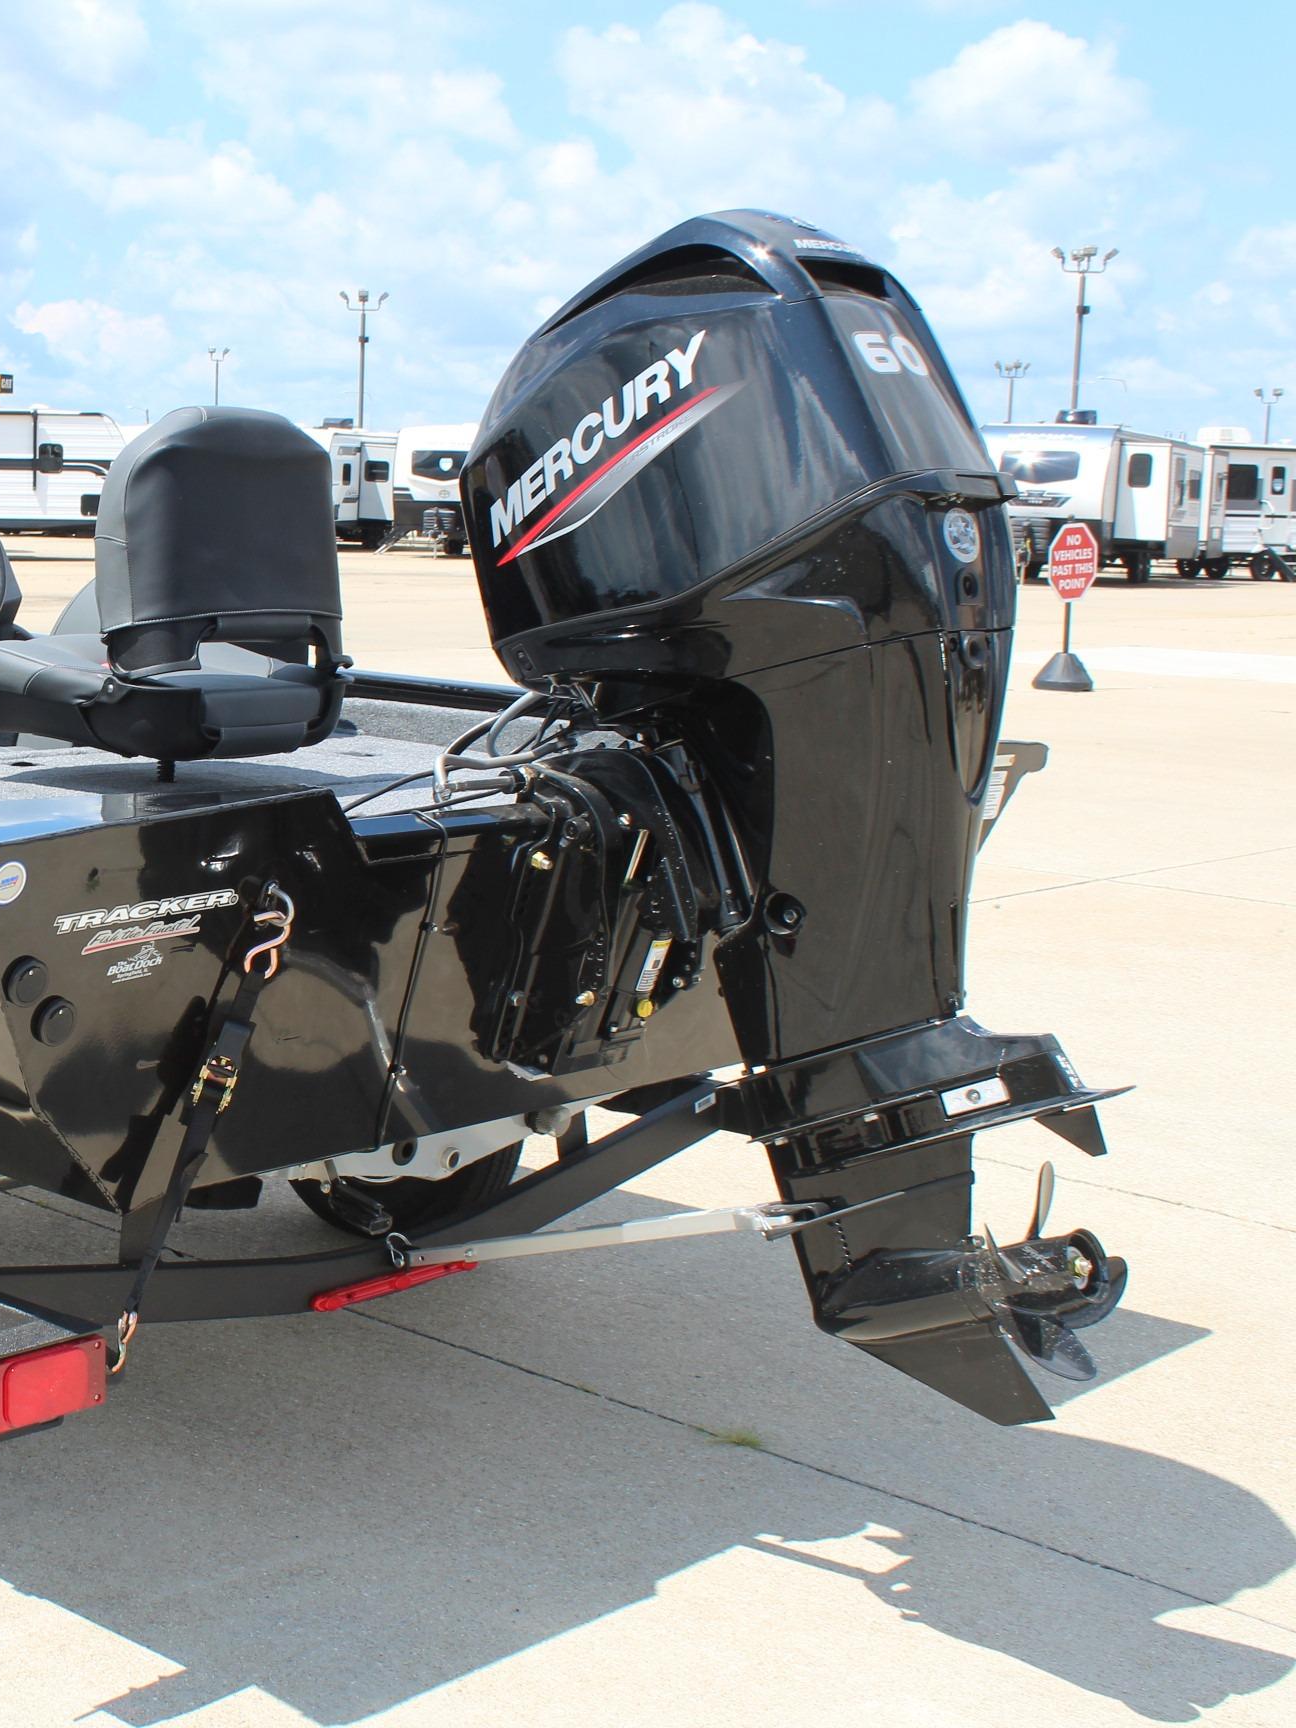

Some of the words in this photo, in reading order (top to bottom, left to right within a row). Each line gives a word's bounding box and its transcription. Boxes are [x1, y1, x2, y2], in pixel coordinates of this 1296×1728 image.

[853, 331, 930, 376] 60
[490, 329, 706, 548] MERCURY
[1067, 535, 1082, 546] NO
[1054, 548, 1092, 561] VEHICLES
[1052, 565, 1073, 576] PAST
[1075, 563, 1093, 574] THIS
[1059, 578, 1085, 590] POINT
[55, 889, 240, 934] TRACKER
